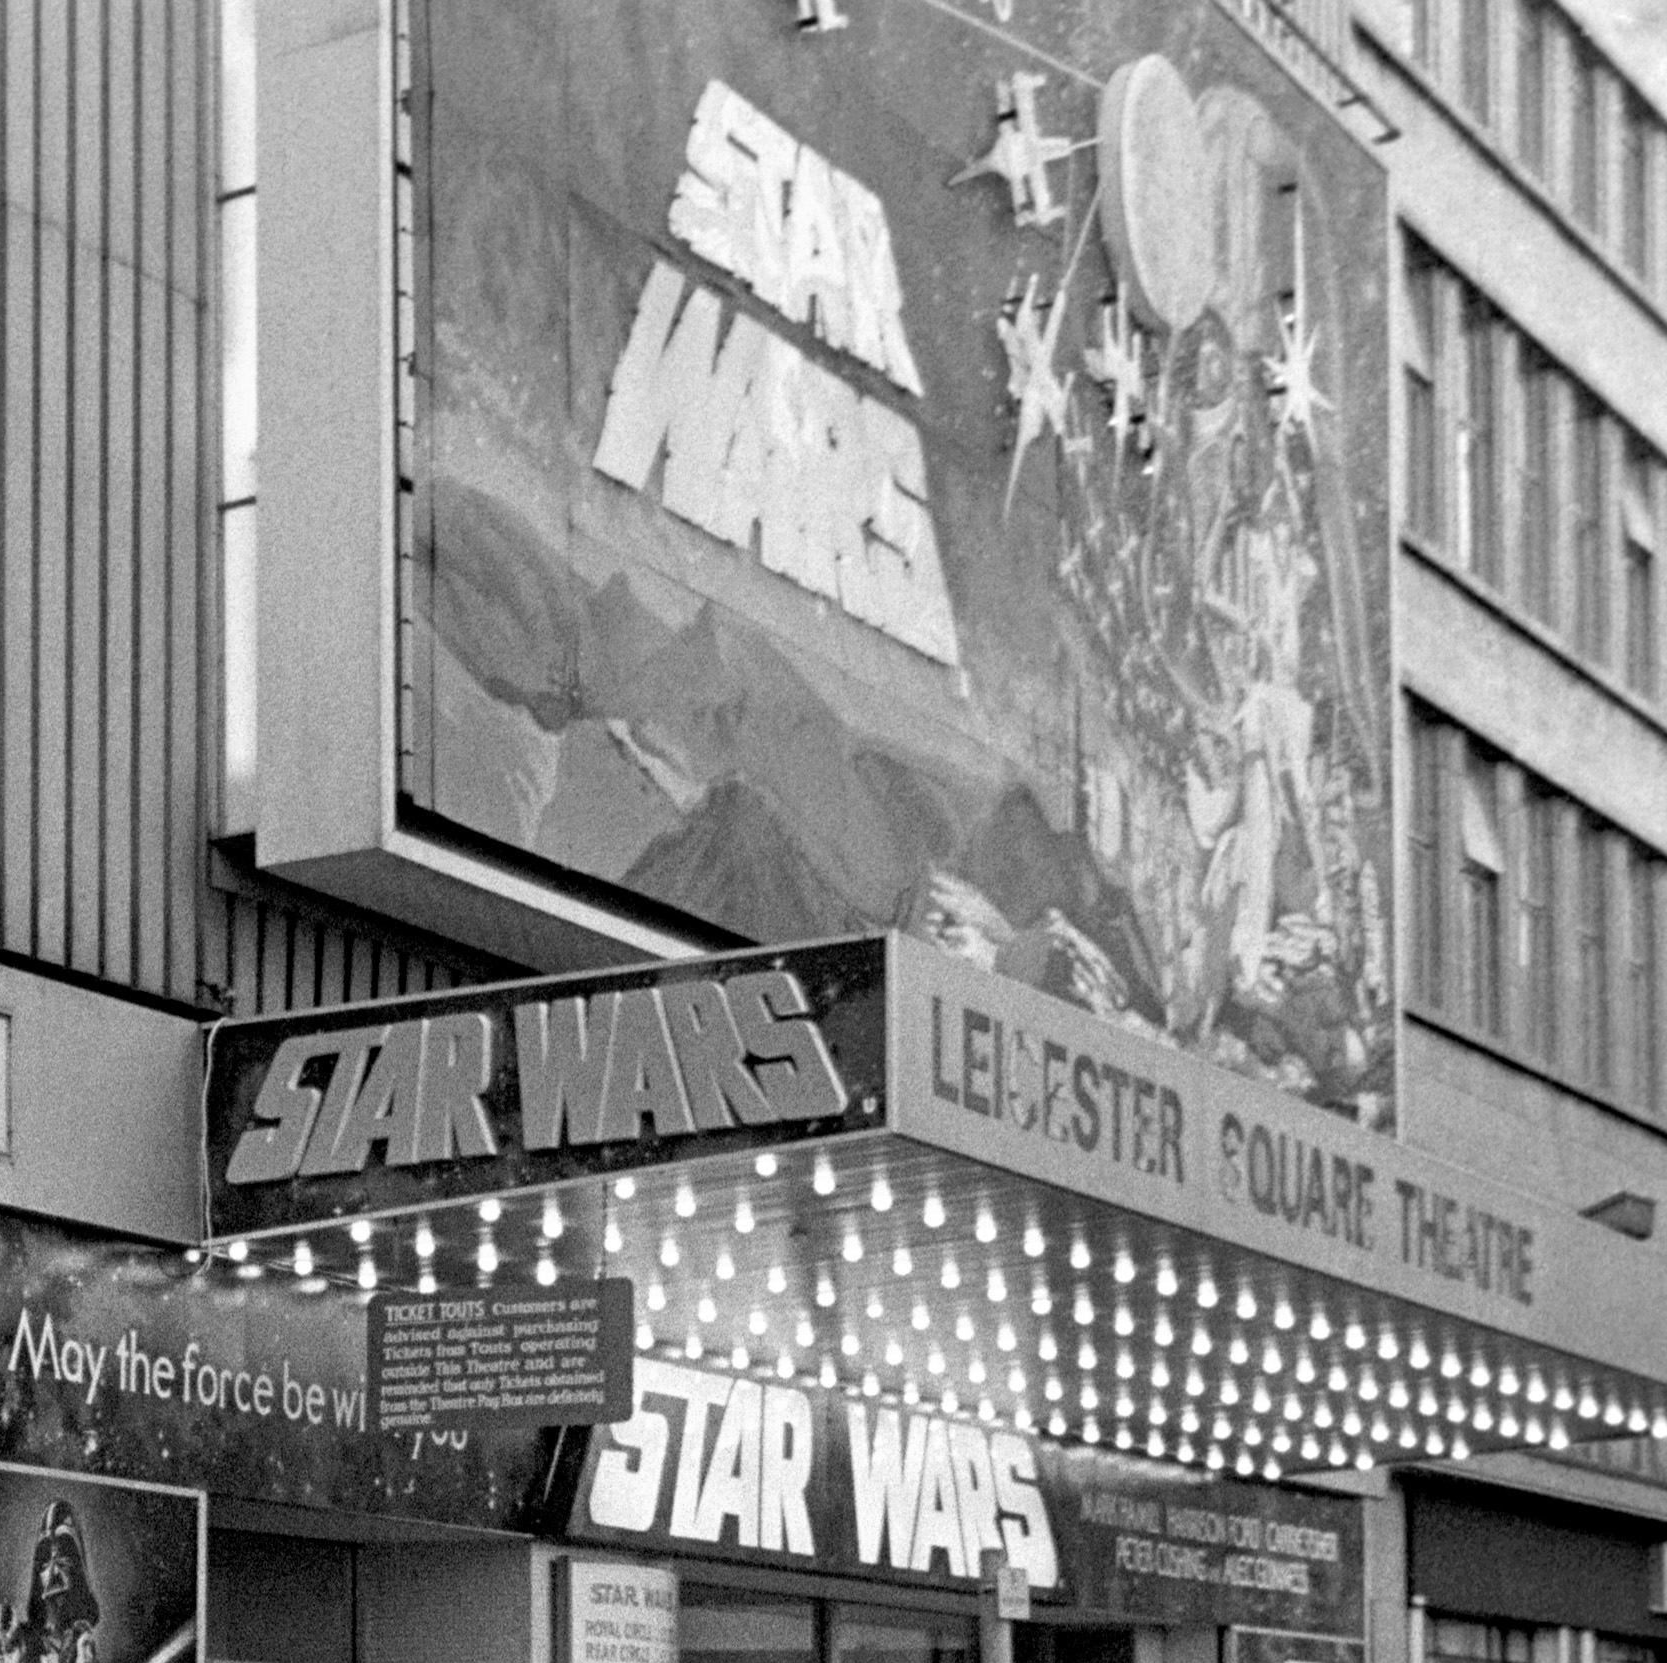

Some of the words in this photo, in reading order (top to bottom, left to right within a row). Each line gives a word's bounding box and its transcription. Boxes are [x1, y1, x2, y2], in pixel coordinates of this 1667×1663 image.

[668, 79, 924, 397] STAR
[592, 258, 960, 666] WARS
[226, 1011, 497, 1184] STAR
[514, 970, 847, 1150] WARS
[930, 995, 1186, 1185] LEICESTER
[1219, 1108, 1375, 1251] SQUARE
[1394, 1178, 1535, 1307] THEATRE
[8, 1306, 106, 1405] May
[116, 1330, 173, 1399] the
[182, 1343, 272, 1417] force
[283, 1360, 326, 1425] be
[332, 1375, 367, 1433] wi
[381, 1363, 431, 1379] outside
[466, 1359, 520, 1374] Theatre
[524, 1357, 555, 1371] and
[560, 1356, 586, 1368] are
[383, 1328, 441, 1344] advised
[447, 1324, 505, 1342] against
[513, 1319, 599, 1337] purchasing
[383, 1346, 432, 1361] Tickets
[436, 1345, 466, 1358] from
[470, 1341, 512, 1356] Touts
[520, 1337, 597, 1353] operating
[385, 1303, 434, 1322] TICKET
[440, 1300, 485, 1320] TOUTS
[492, 1301, 566, 1316] Customers
[570, 1299, 597, 1311] are
[589, 1355, 815, 1557] STAR
[846, 1401, 1060, 1588] WARS
[589, 1583, 639, 1607] STAR
